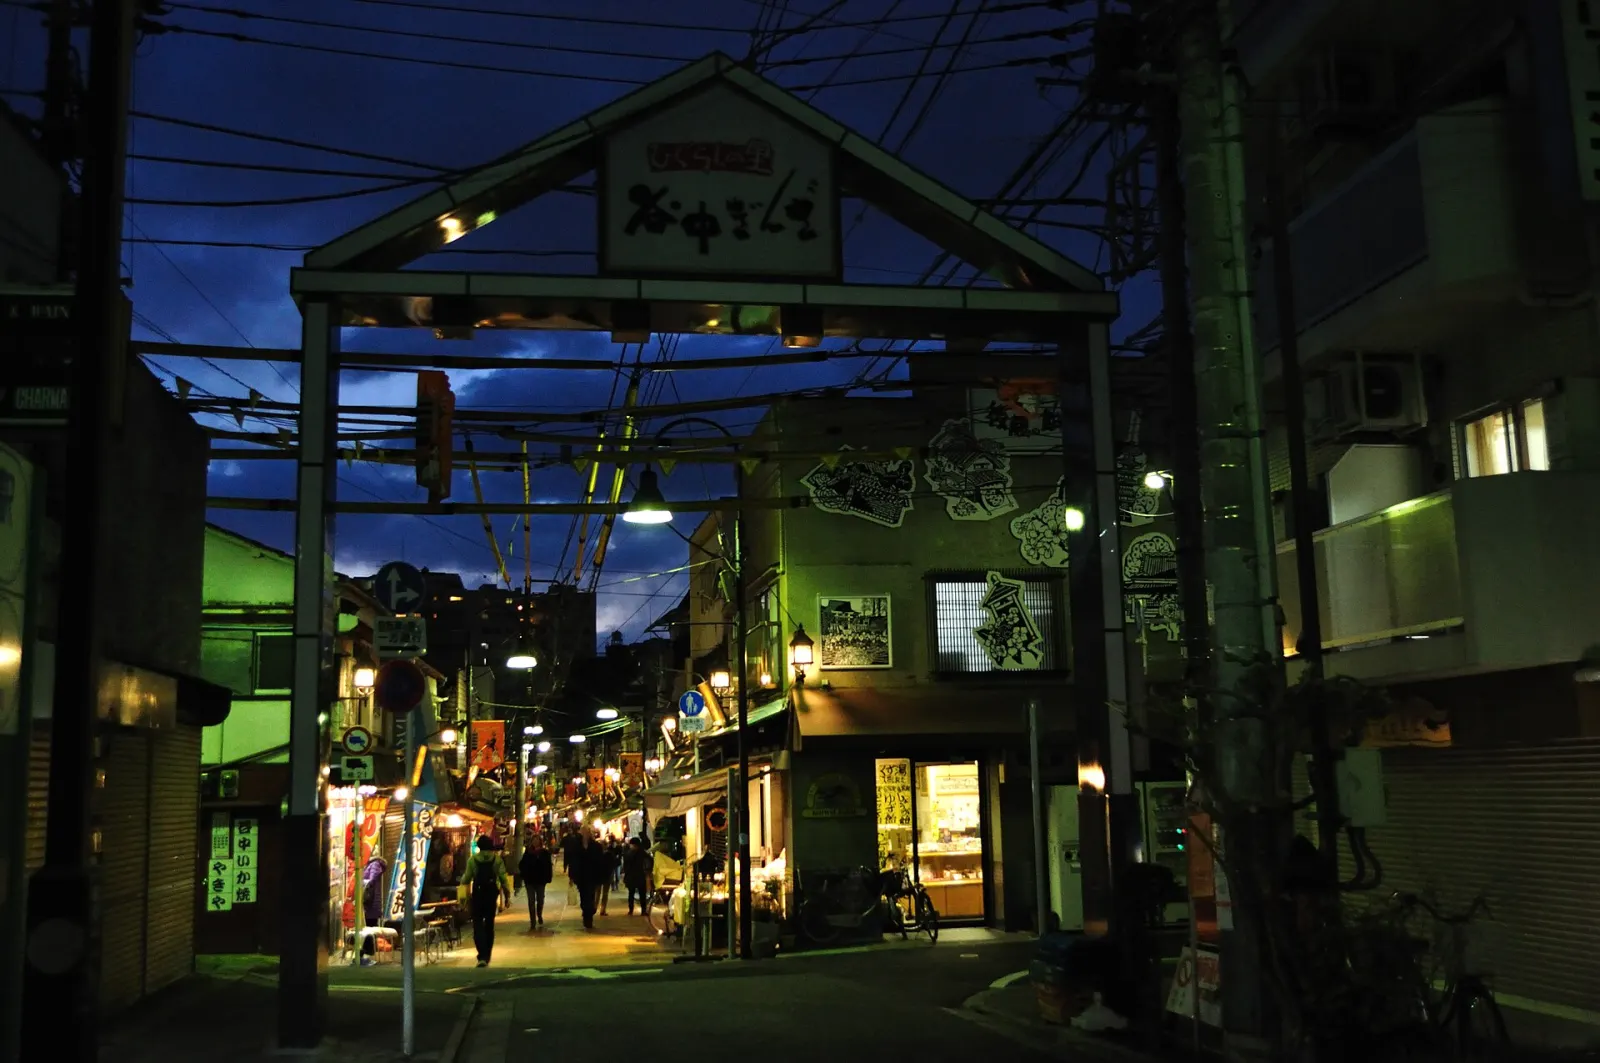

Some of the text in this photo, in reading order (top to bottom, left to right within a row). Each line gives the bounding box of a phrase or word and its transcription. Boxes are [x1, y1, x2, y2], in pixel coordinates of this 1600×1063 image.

[623, 167, 820, 255] 谷中ぎんざ
[211, 861, 227, 910] やきや
[235, 820, 252, 902] 谷中いか焼
